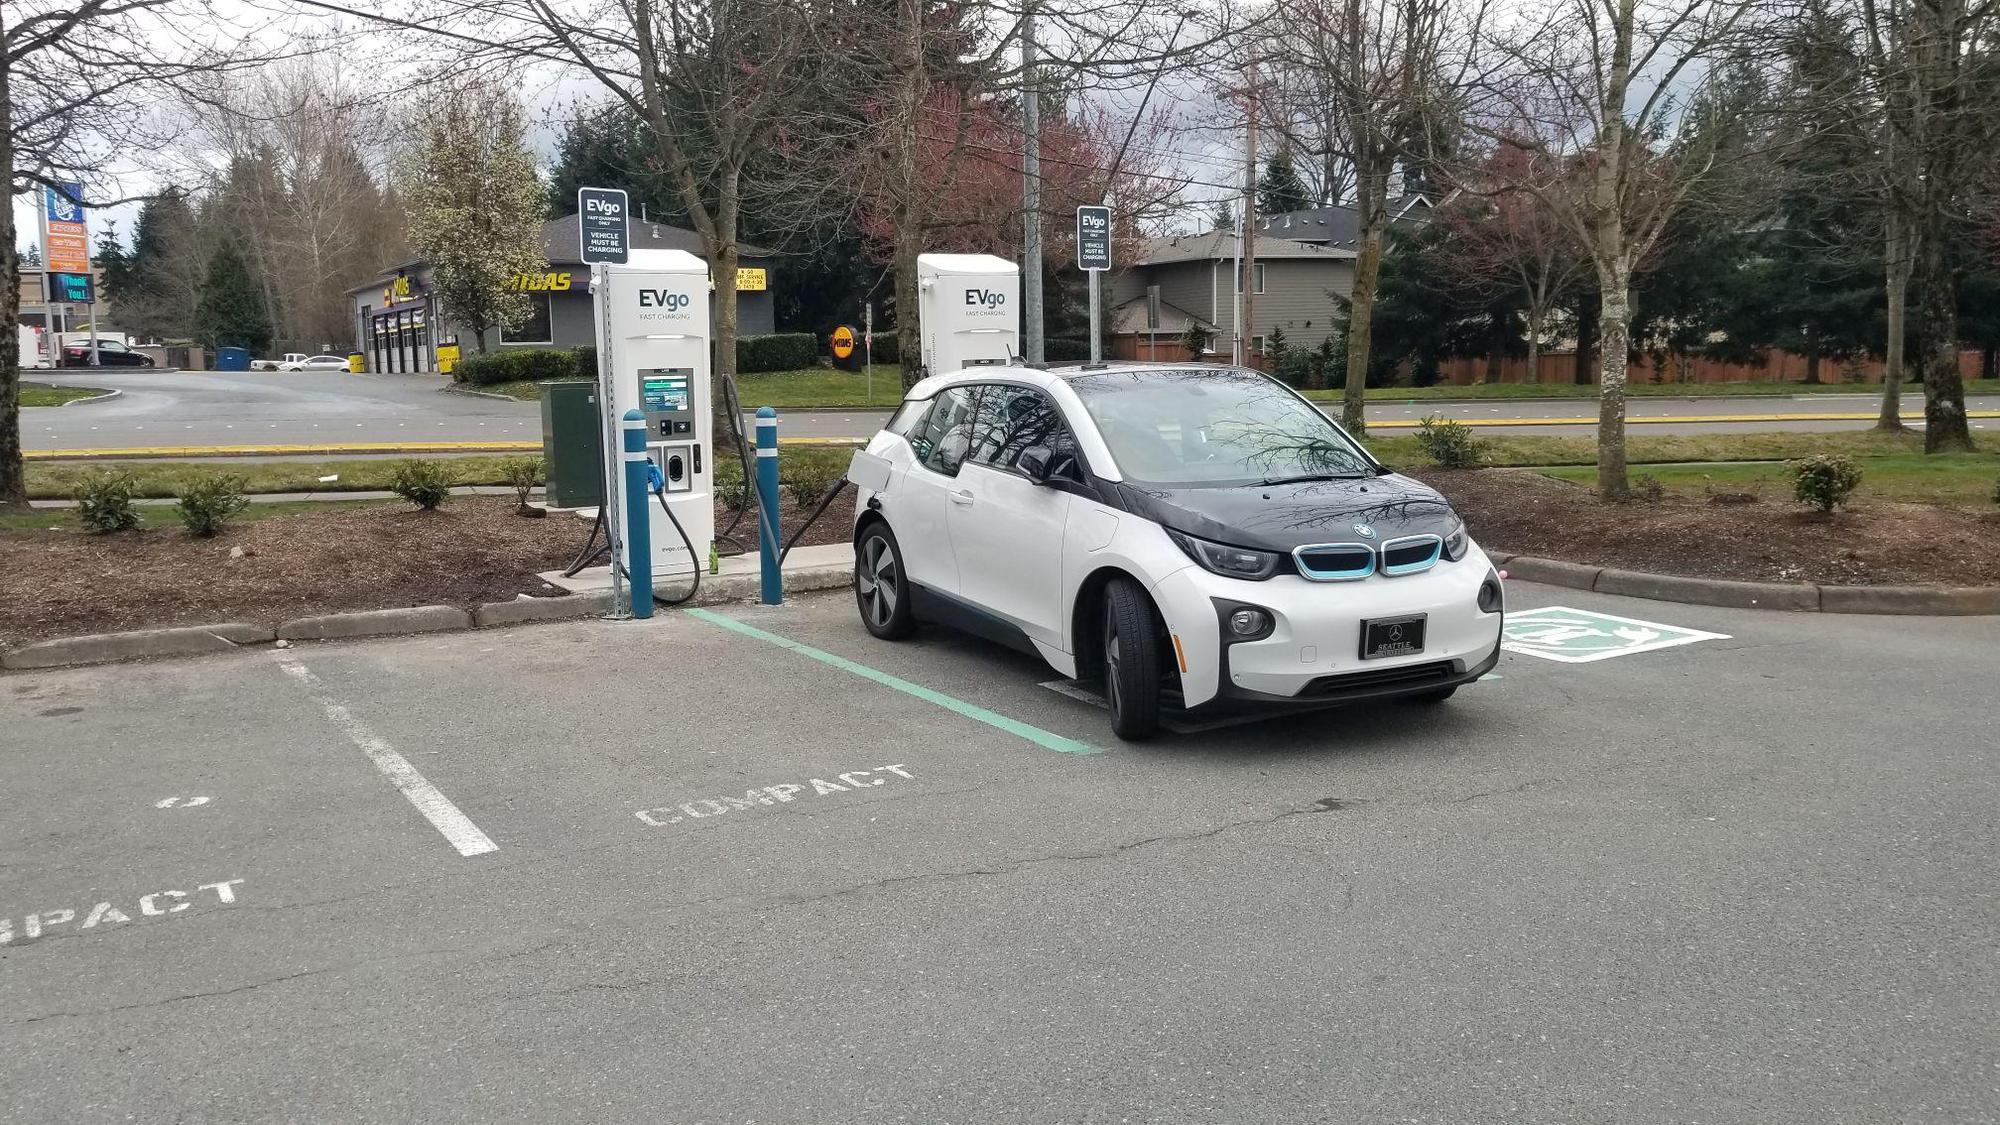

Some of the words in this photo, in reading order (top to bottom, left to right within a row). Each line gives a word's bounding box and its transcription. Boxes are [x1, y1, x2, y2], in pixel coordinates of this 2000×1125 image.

[586, 199, 620, 215] EVgo
[1082, 215, 1105, 229] EVgo
[590, 232, 619, 240] VEHICLE
[587, 246, 623, 254] CHARGING
[65, 276, 87, 287] Thank
[497, 272, 571, 291] IDAS
[68, 289, 85, 300] You!
[639, 289, 690, 312] EVgo
[965, 289, 1006, 309] EVgo
[657, 313, 691, 321] CHARGING
[1377, 641, 1411, 651] SEATTLE
[635, 763, 915, 826] COMPACT
